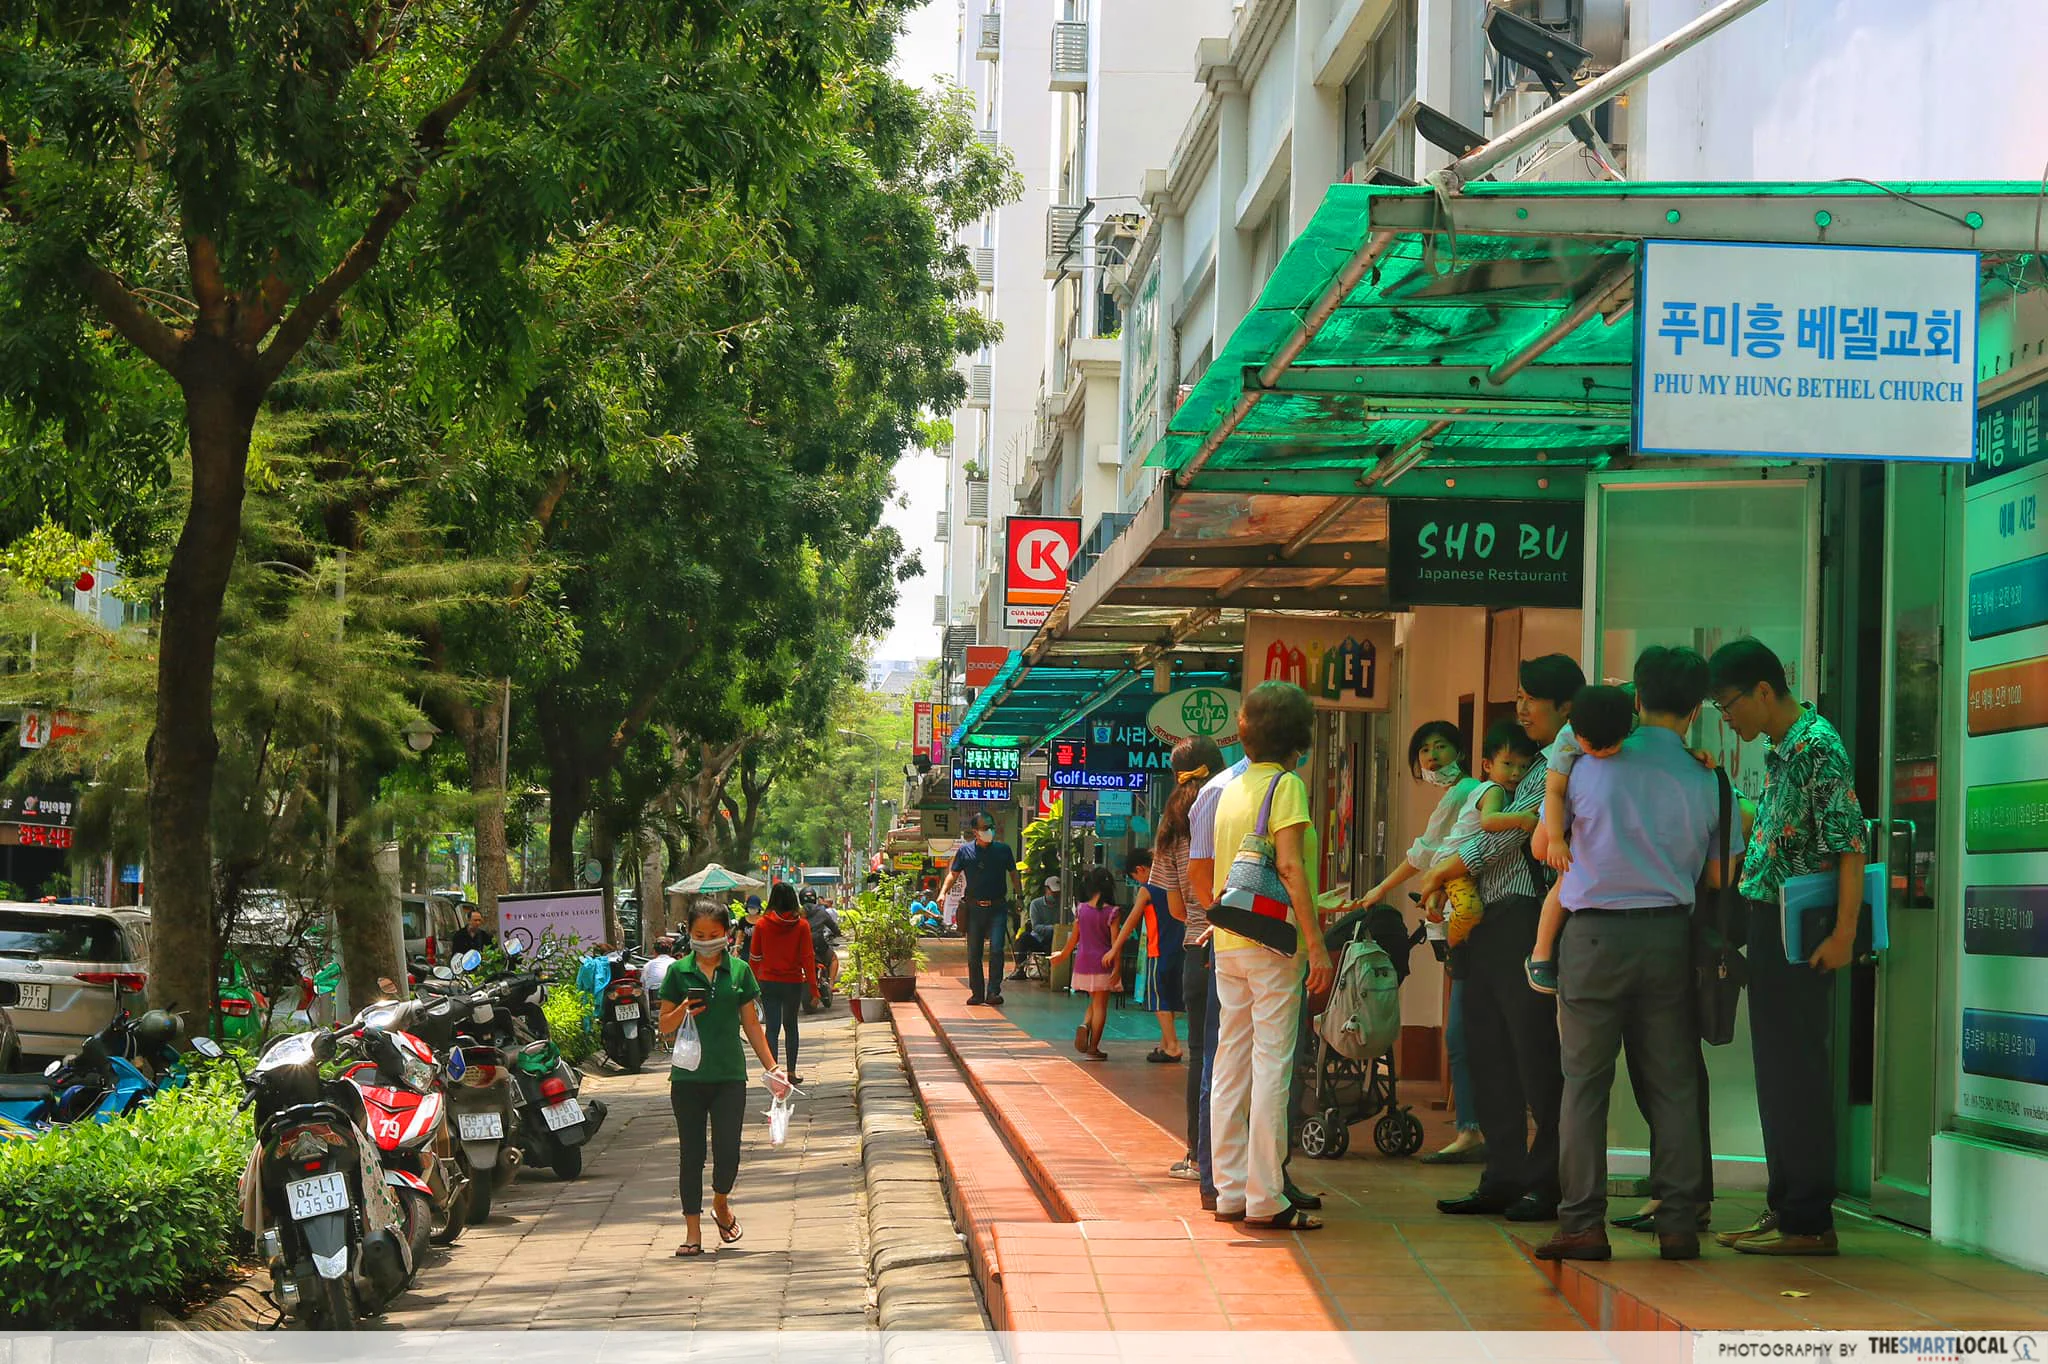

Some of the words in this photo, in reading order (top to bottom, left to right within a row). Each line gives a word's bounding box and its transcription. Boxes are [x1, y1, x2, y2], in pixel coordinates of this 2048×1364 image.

[1658, 301, 1785, 359] 푸미흥
[1797, 305, 1961, 364] 베델교회
[1654, 373, 1694, 394] PHU
[1698, 375, 1730, 395] MY
[1735, 376, 1792, 397] HUNG
[1797, 378, 1875, 400] BETHEL
[1879, 380, 1964, 402] CHURCH
[1971, 410, 2005, 476] 미흥
[1417, 521, 1496, 561] SHO
[1518, 523, 1568, 560] BU
[1417, 567, 1484, 583] Japanese
[1488, 568, 1568, 582] Restaurant
[954, 779, 982, 788] AIRLINE
[1054, 770, 1080, 785] Golf
[1082, 771, 1123, 787] Lesson
[1128, 773, 1144, 787] 2F
[17, 996, 49, 1008] 77.19
[379, 1119, 401, 1139] 79
